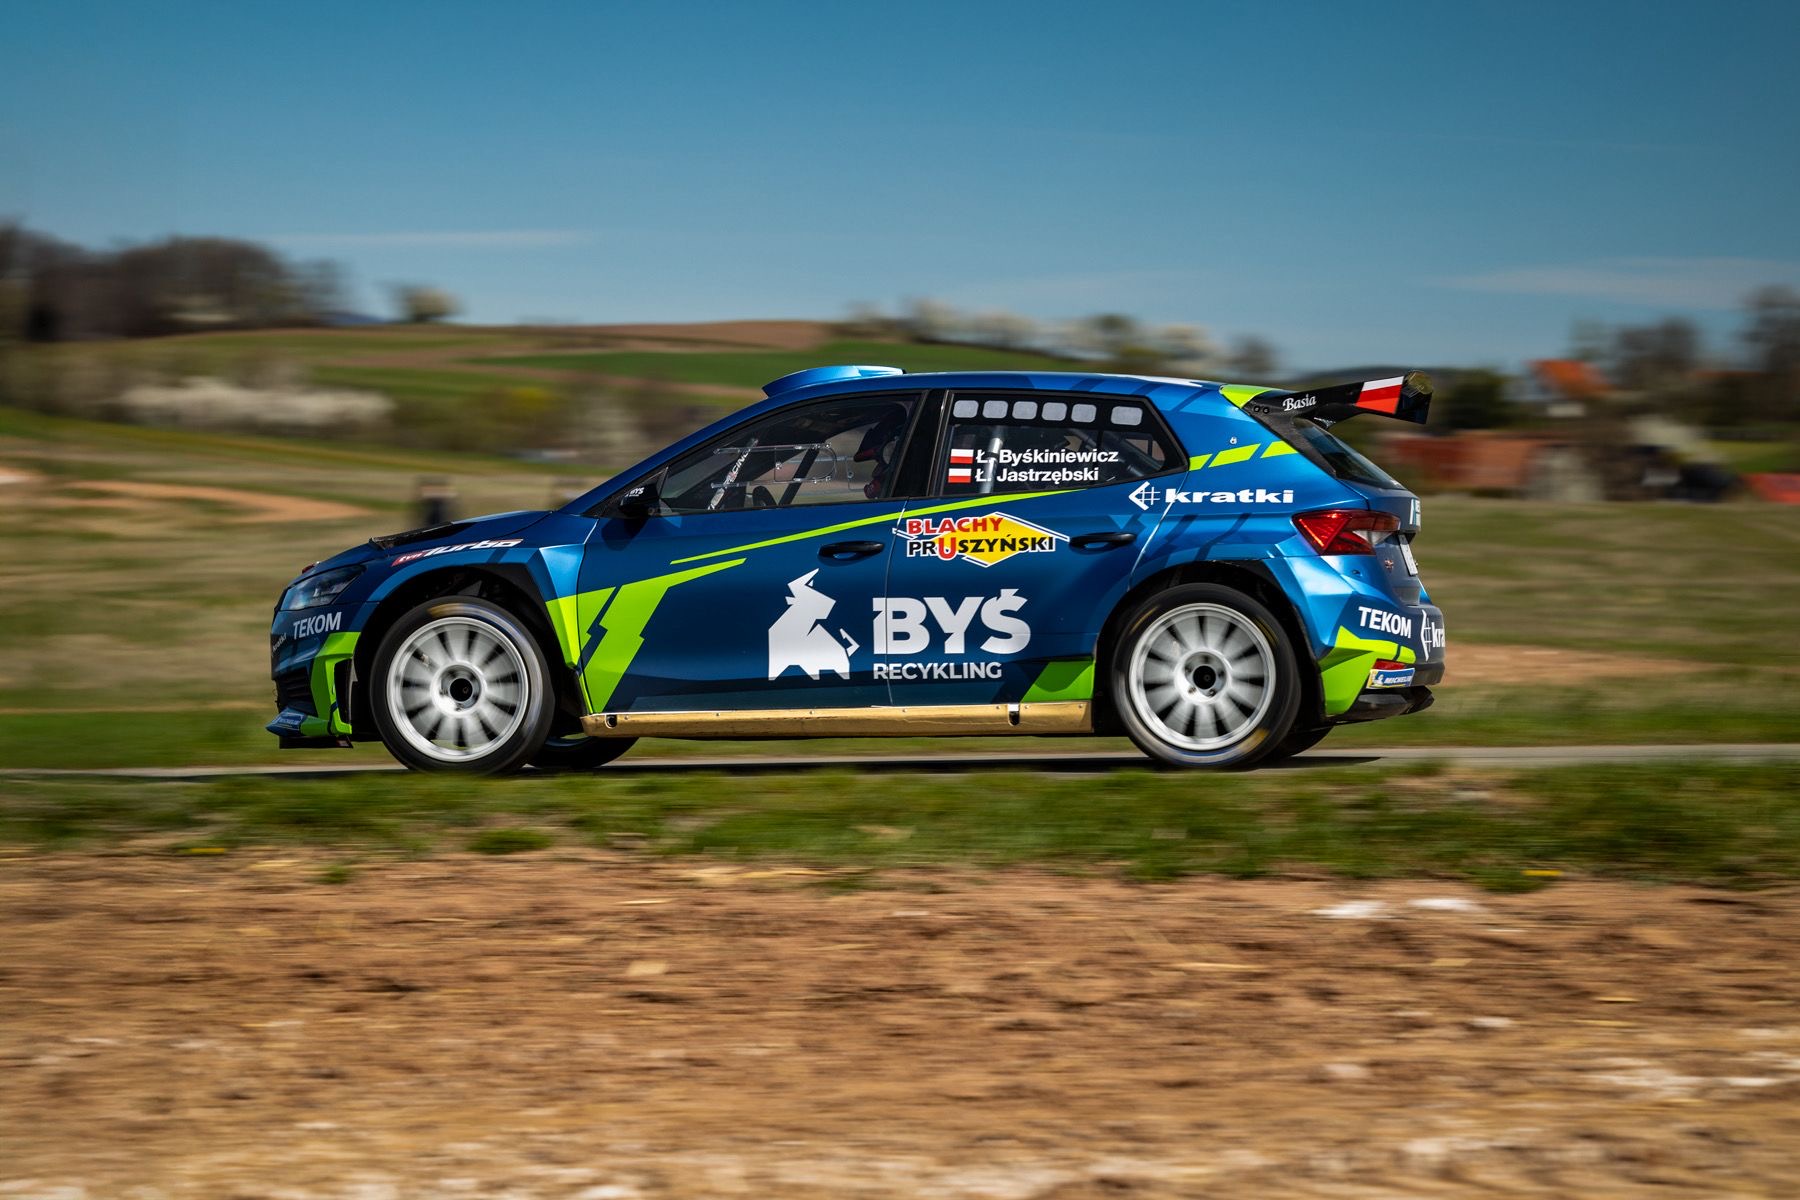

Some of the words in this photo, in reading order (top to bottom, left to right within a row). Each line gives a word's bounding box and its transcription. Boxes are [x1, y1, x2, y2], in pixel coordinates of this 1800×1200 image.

[1282, 393, 1317, 412] Basia
[976, 448, 993, 464] Ł.
[999, 448, 1119, 467] Byśkiniewicz
[975, 467, 992, 482] Ł.
[996, 467, 1100, 485] Jastrzębski
[1165, 488, 1294, 504] kratki
[906, 517, 1004, 535] BLACHY
[906, 534, 1056, 561] PRUSZYŃSKI
[292, 611, 343, 640] TEKOM
[872, 588, 1032, 655] BYŚ
[1358, 605, 1412, 639] TEKOM
[872, 661, 1003, 681] RECYKLING
